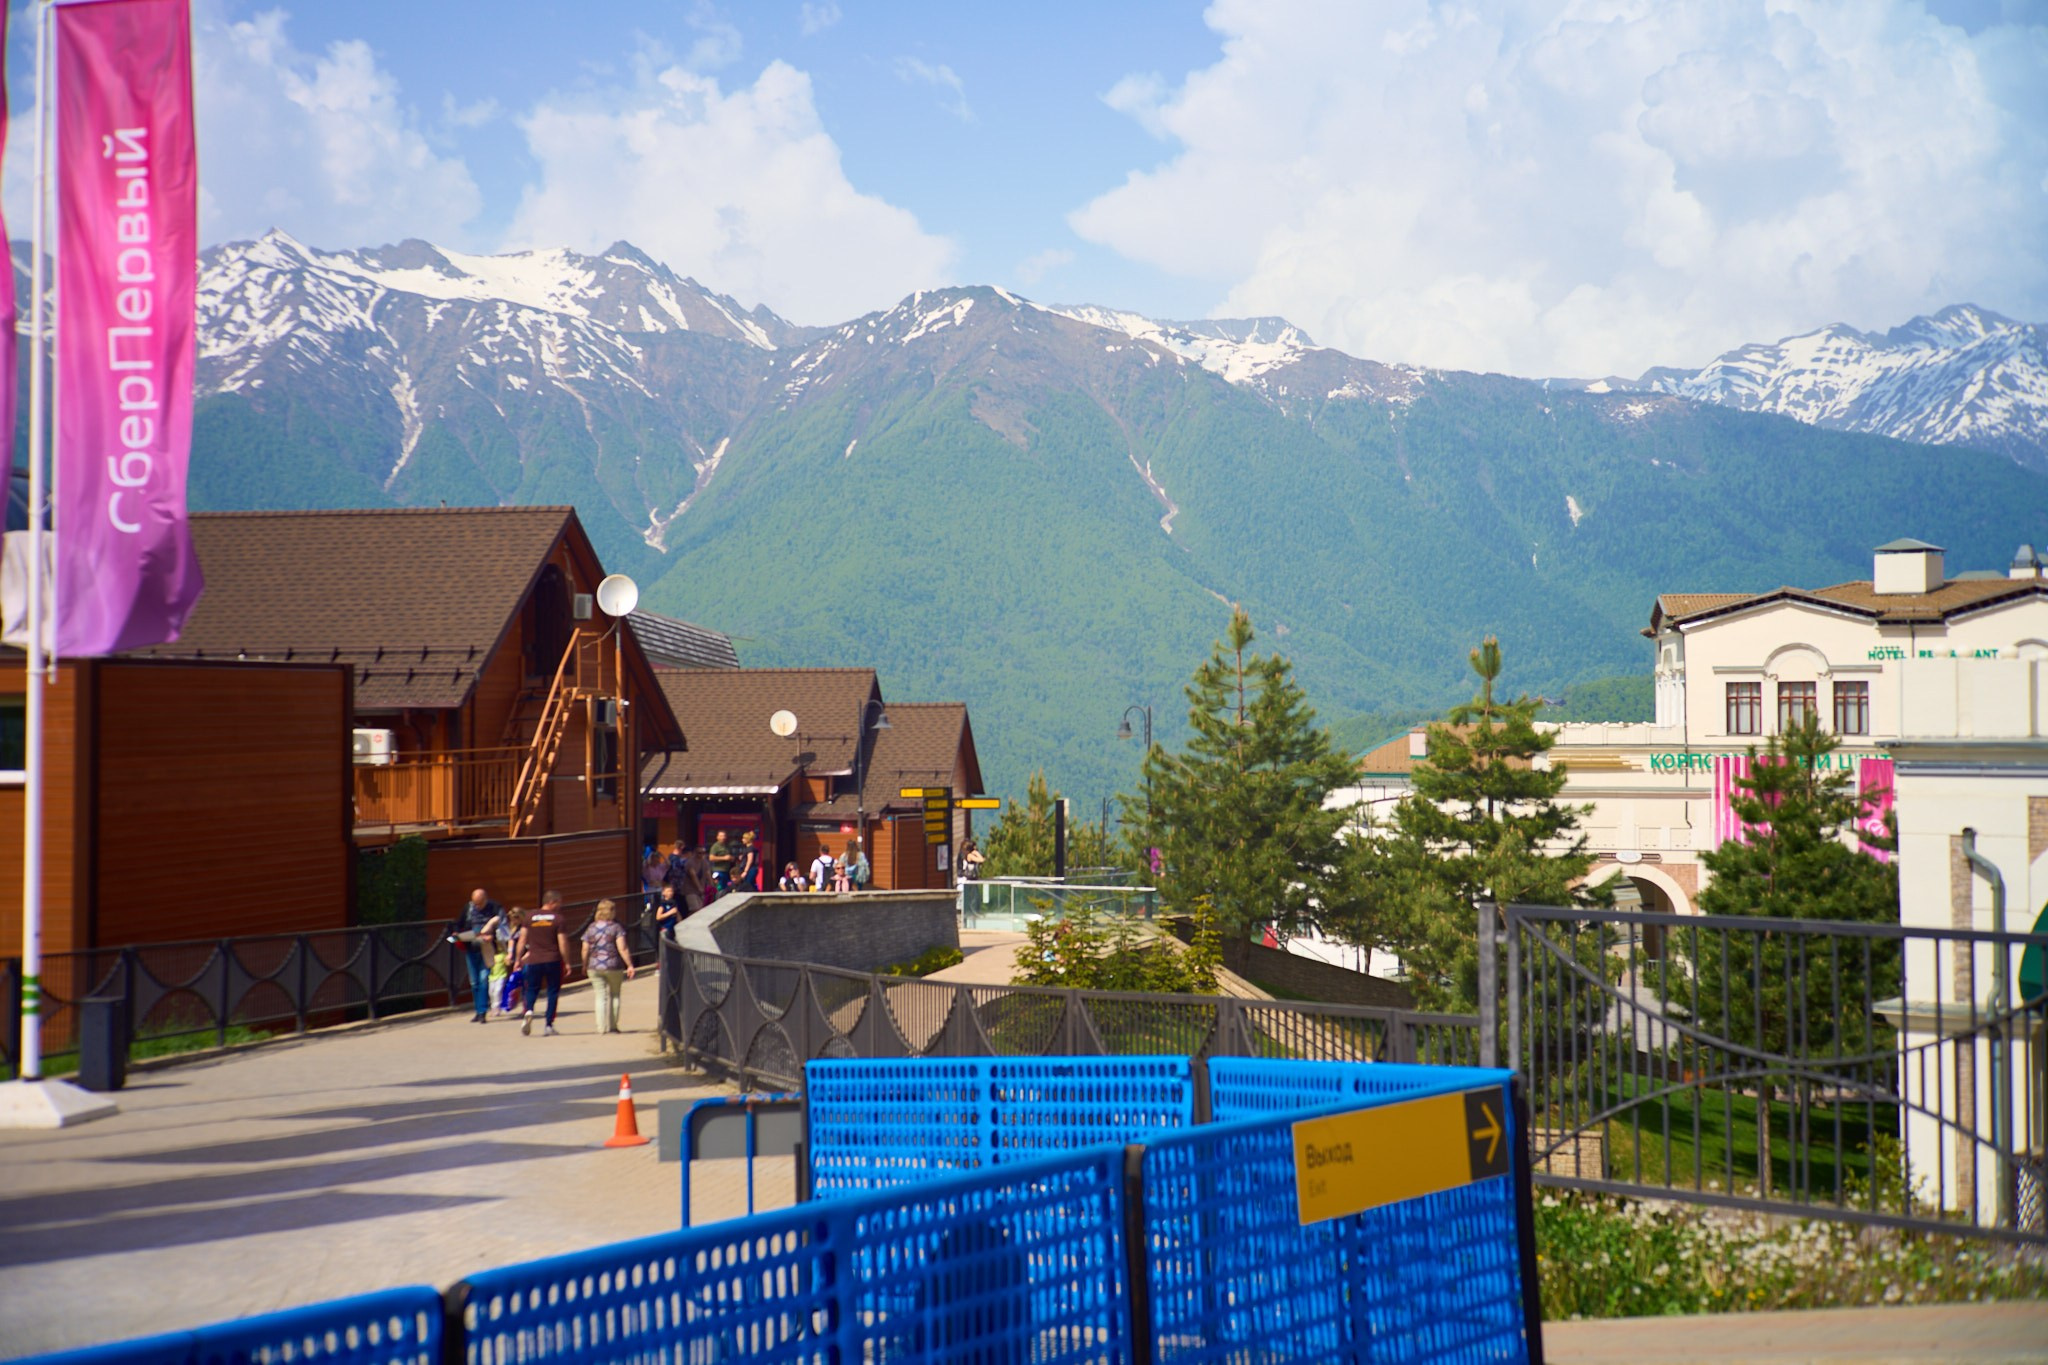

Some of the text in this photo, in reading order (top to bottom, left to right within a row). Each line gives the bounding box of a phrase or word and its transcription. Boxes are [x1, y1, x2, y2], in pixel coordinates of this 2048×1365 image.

[103, 127, 157, 534] СберПервый
[1868, 649, 1999, 660] HOTEL REAANT
[1304, 1142, 1354, 1169] Выход
